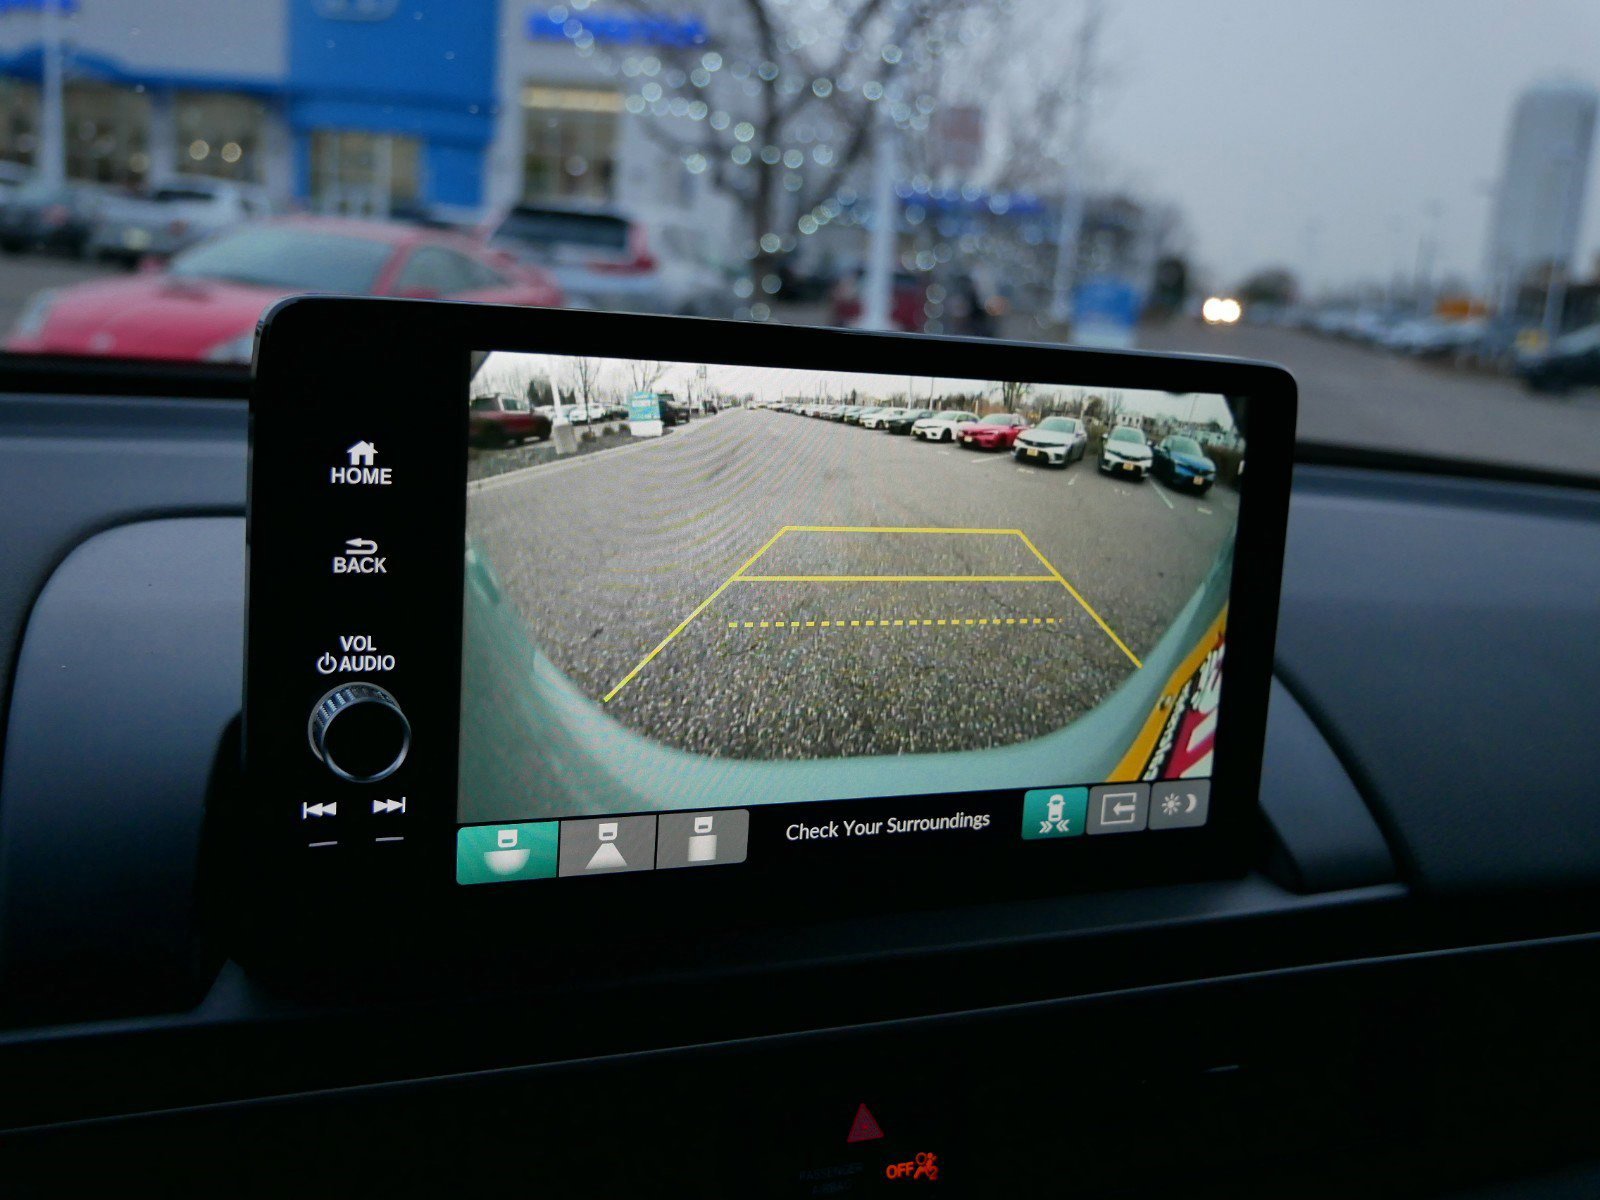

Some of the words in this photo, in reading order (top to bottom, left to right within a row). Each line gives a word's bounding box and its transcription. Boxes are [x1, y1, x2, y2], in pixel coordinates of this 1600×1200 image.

[332, 467, 392, 484] HOME
[334, 557, 387, 573] BACK
[340, 636, 376, 651] VOL
[339, 655, 395, 672] AUDIO
[786, 821, 838, 840] Check
[844, 820, 883, 836] Your
[887, 812, 990, 833] Surroundings
[886, 1162, 913, 1179] OFF
